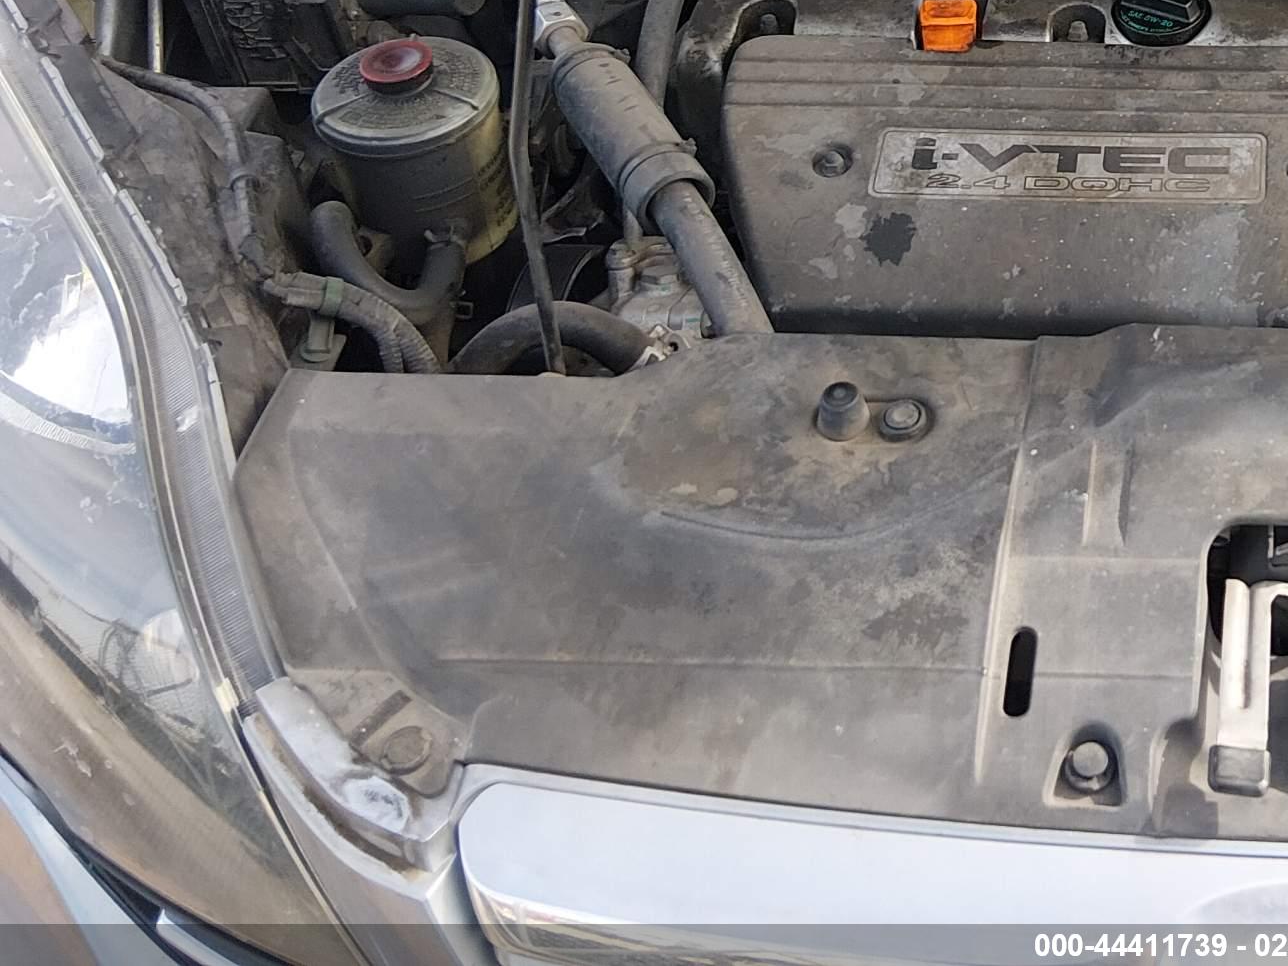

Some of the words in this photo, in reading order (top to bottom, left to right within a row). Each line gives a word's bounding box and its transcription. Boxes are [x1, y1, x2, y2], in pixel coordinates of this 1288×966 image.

[911, 137, 1232, 175] i-VTEC
[926, 173, 1011, 190] 2.4
[1023, 175, 1211, 194] DOHC
